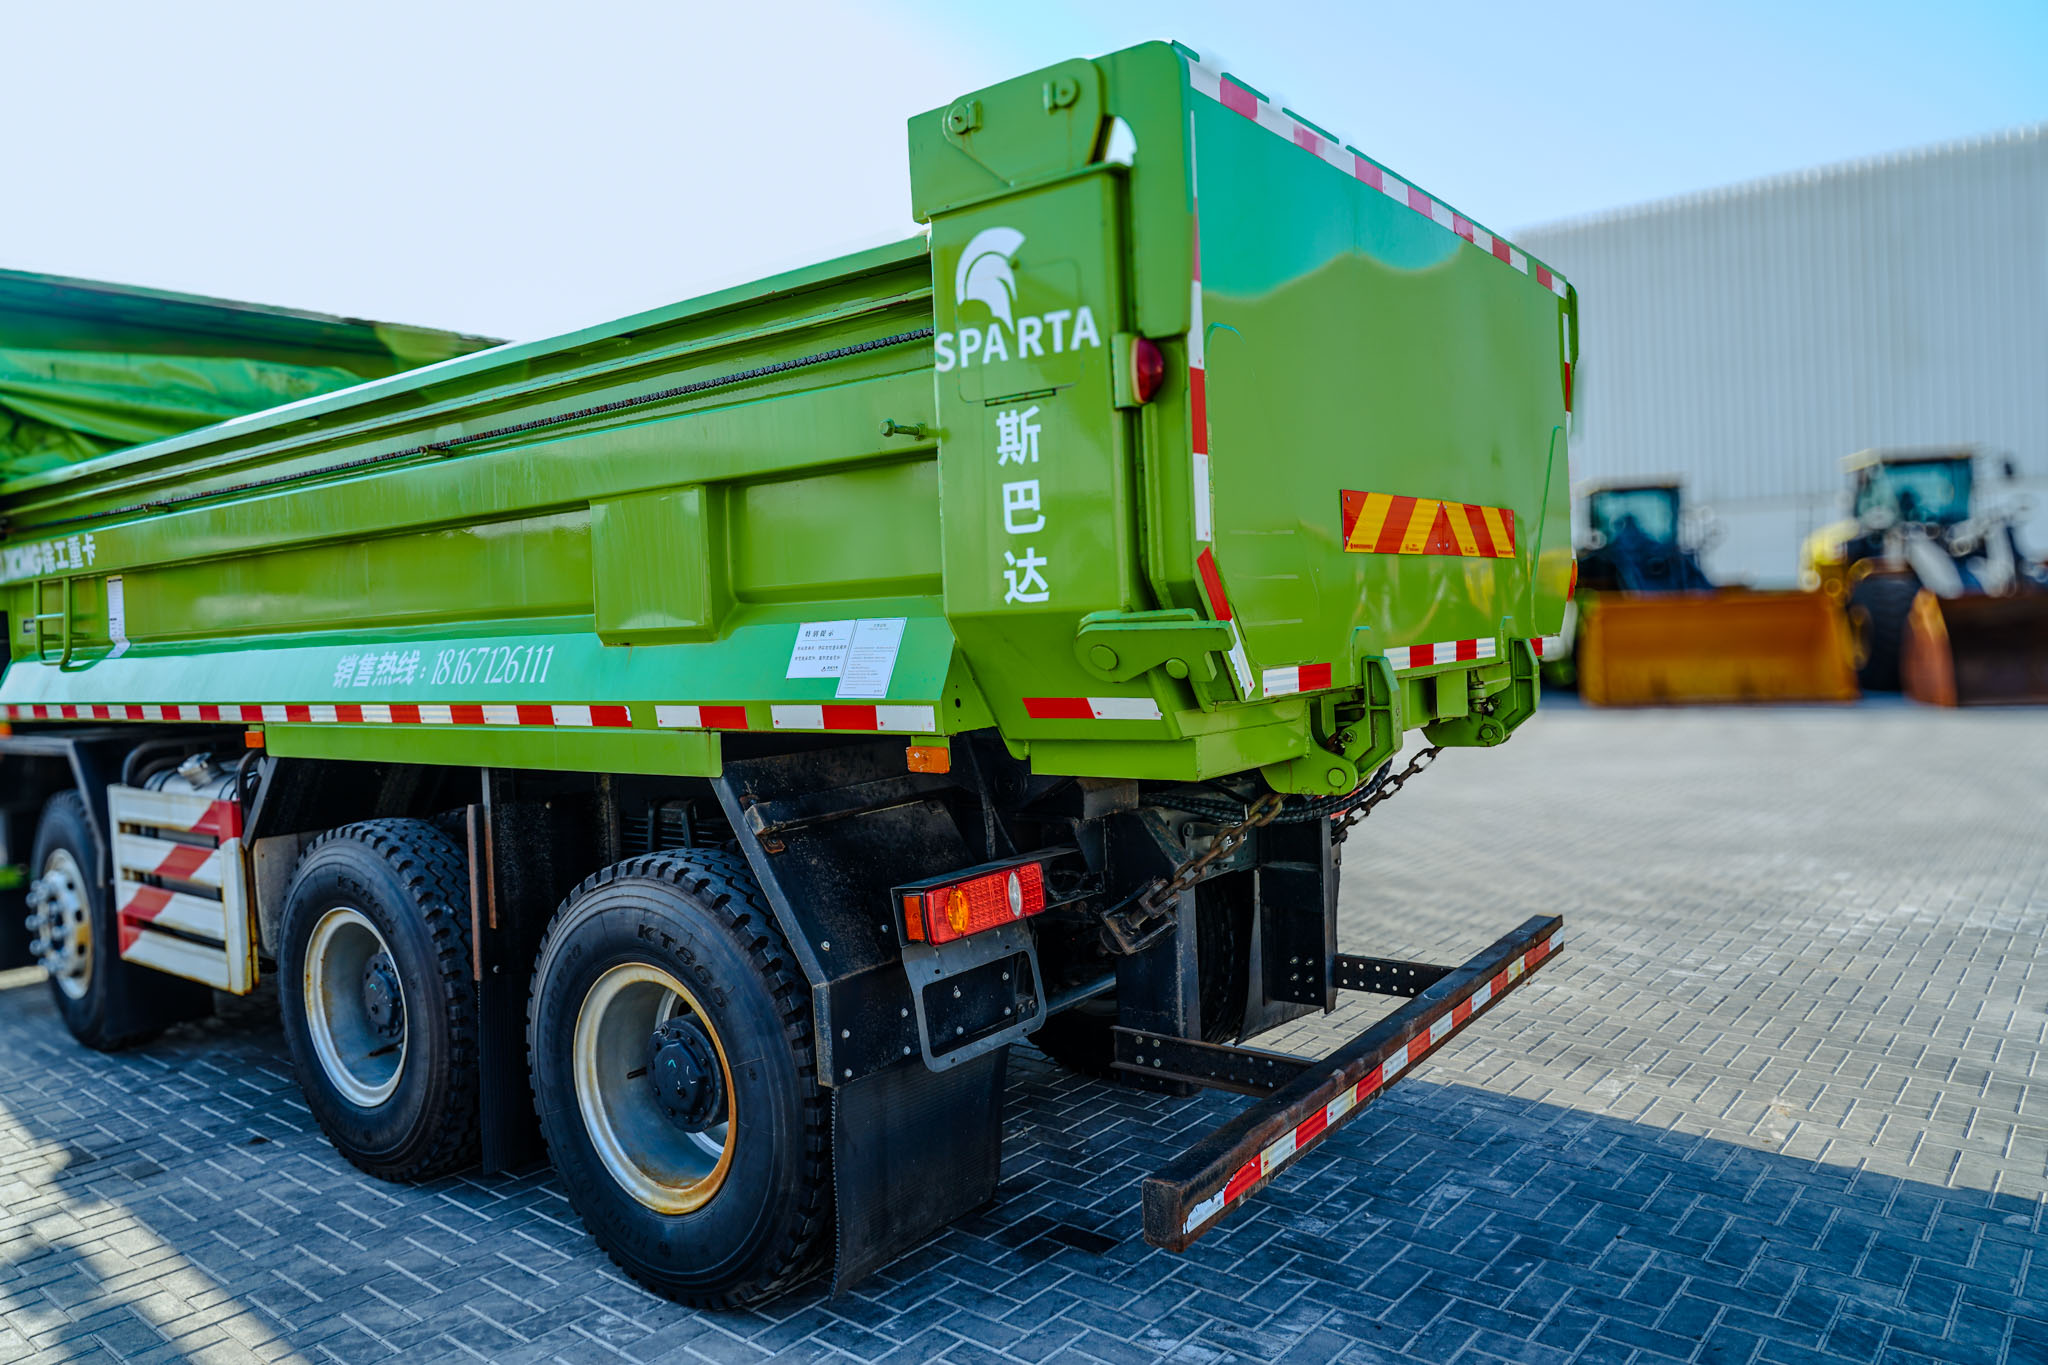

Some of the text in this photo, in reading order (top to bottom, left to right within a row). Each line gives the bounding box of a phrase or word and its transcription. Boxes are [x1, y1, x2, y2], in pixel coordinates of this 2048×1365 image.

[935, 305, 1100, 373] SPARTA
[996, 405, 1050, 604] 斯巴达
[637, 923, 729, 1009] KT865
